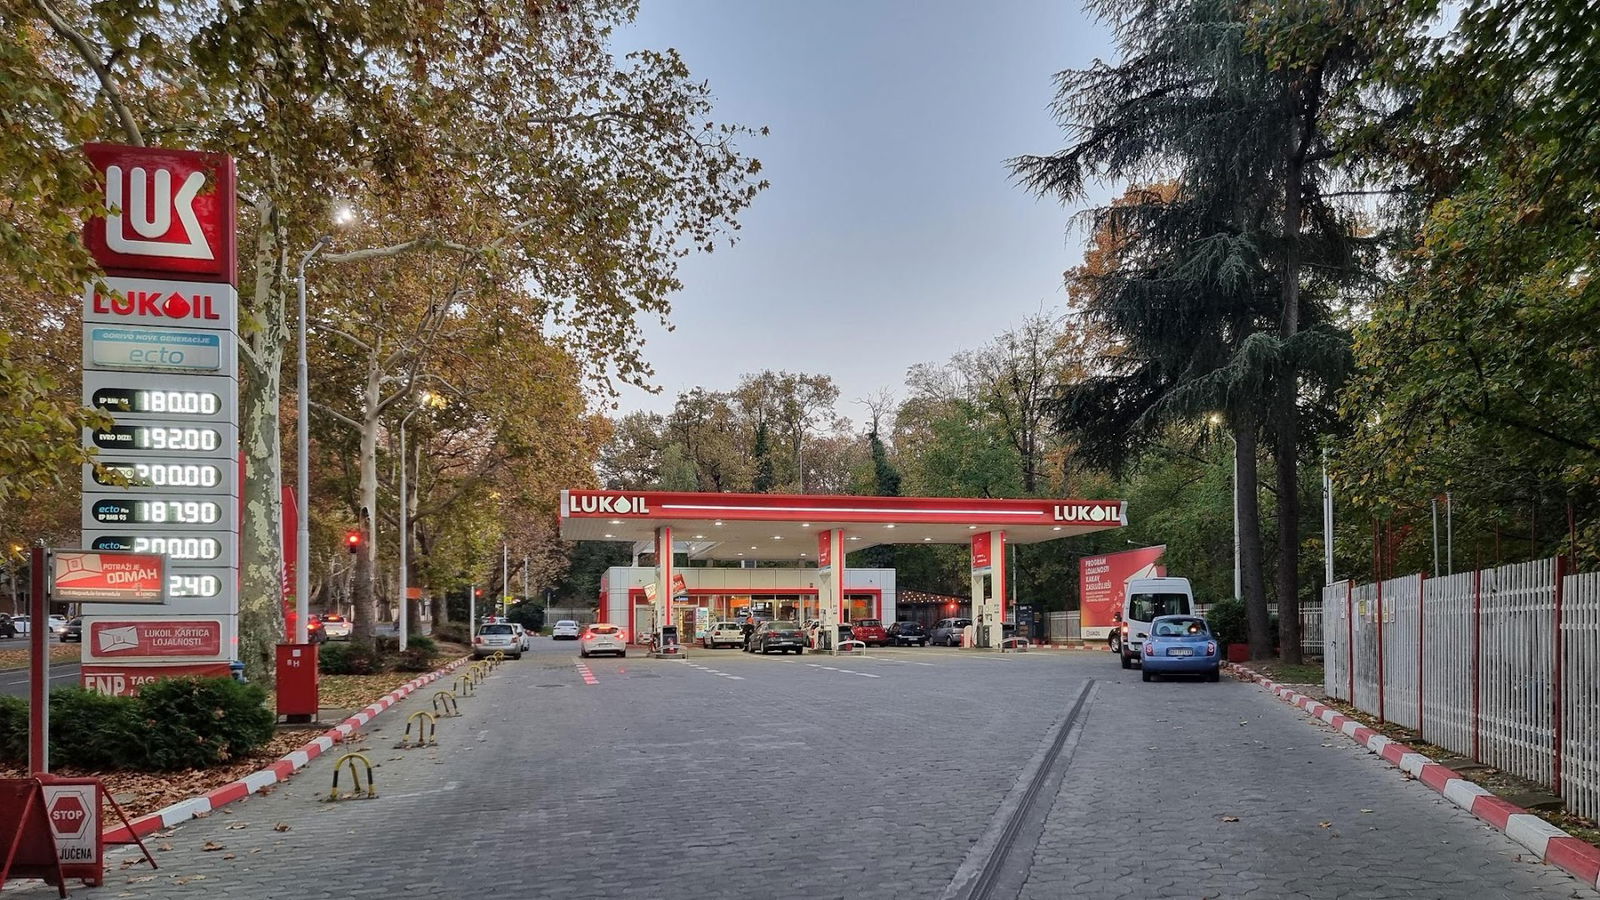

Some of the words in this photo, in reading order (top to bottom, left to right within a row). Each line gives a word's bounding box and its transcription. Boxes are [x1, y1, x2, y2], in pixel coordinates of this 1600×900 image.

[93, 291, 220, 320] LUKOIL
[102, 332, 134, 340] GORIVO
[159, 335, 211, 344] GENERACIJE
[129, 346, 184, 364] ecto
[143, 391, 216, 414] 180.00
[143, 428, 216, 450] 192.00
[98, 505, 120, 513] ecto
[143, 501, 216, 522] 187.90
[570, 495, 649, 514] LUKOIL
[1054, 505, 1120, 522] LUKOIL
[103, 563, 131, 571] POTRAŽI
[107, 569, 157, 584] ODMAH
[144, 629, 172, 637] LUKOIL
[175, 629, 210, 637] KARTICA
[153, 638, 202, 646] LOJALNOSTI
[53, 810, 83, 820] STOP
